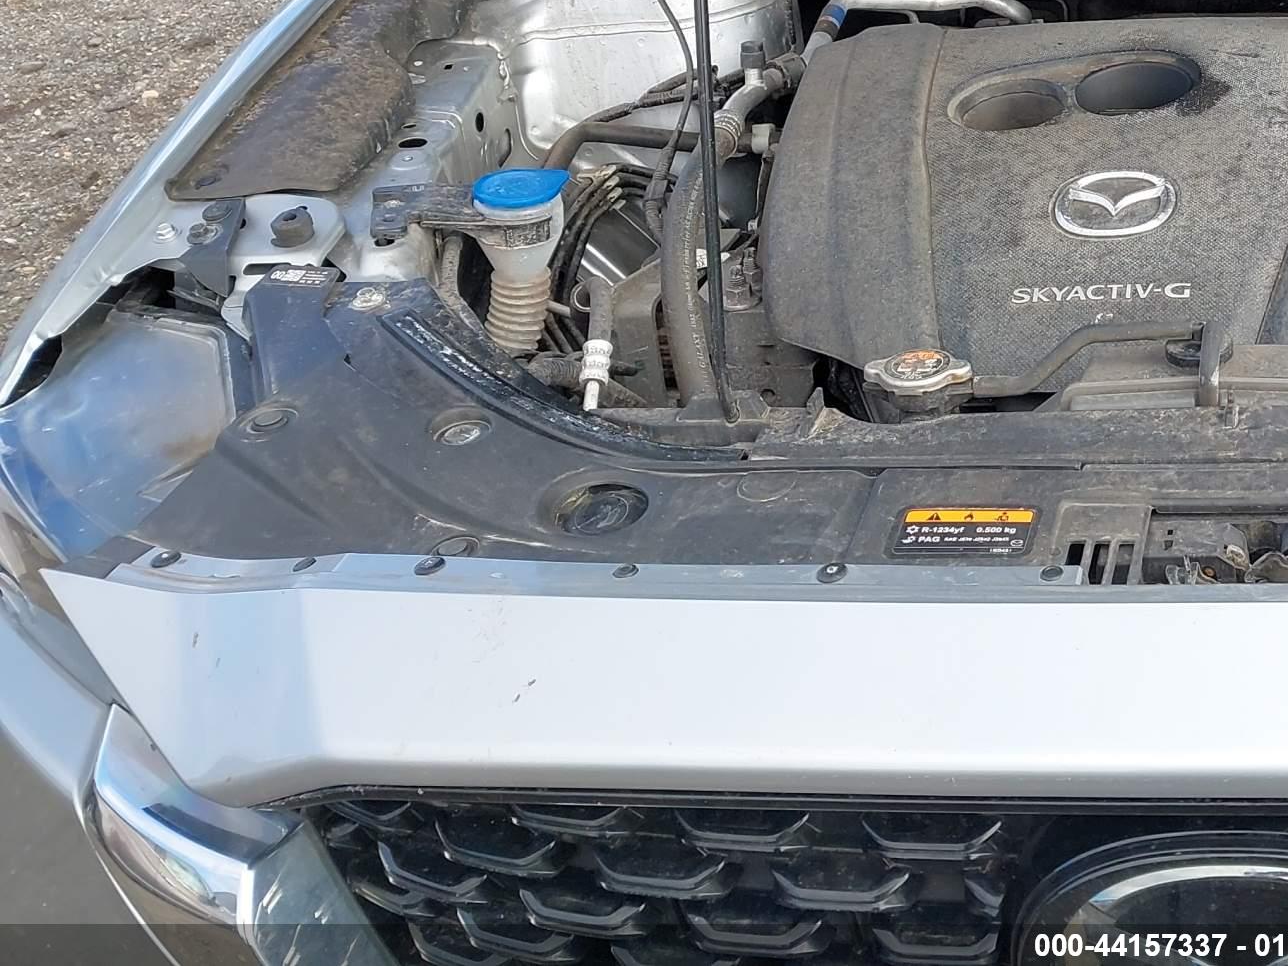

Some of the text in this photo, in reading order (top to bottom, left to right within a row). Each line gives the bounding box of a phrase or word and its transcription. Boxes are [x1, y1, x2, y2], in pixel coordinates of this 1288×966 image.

[1011, 282, 1192, 304] SKYACTIV-G
[921, 525, 1017, 535] R-1234yf 0.500 kg
[917, 535, 941, 544] PAG
